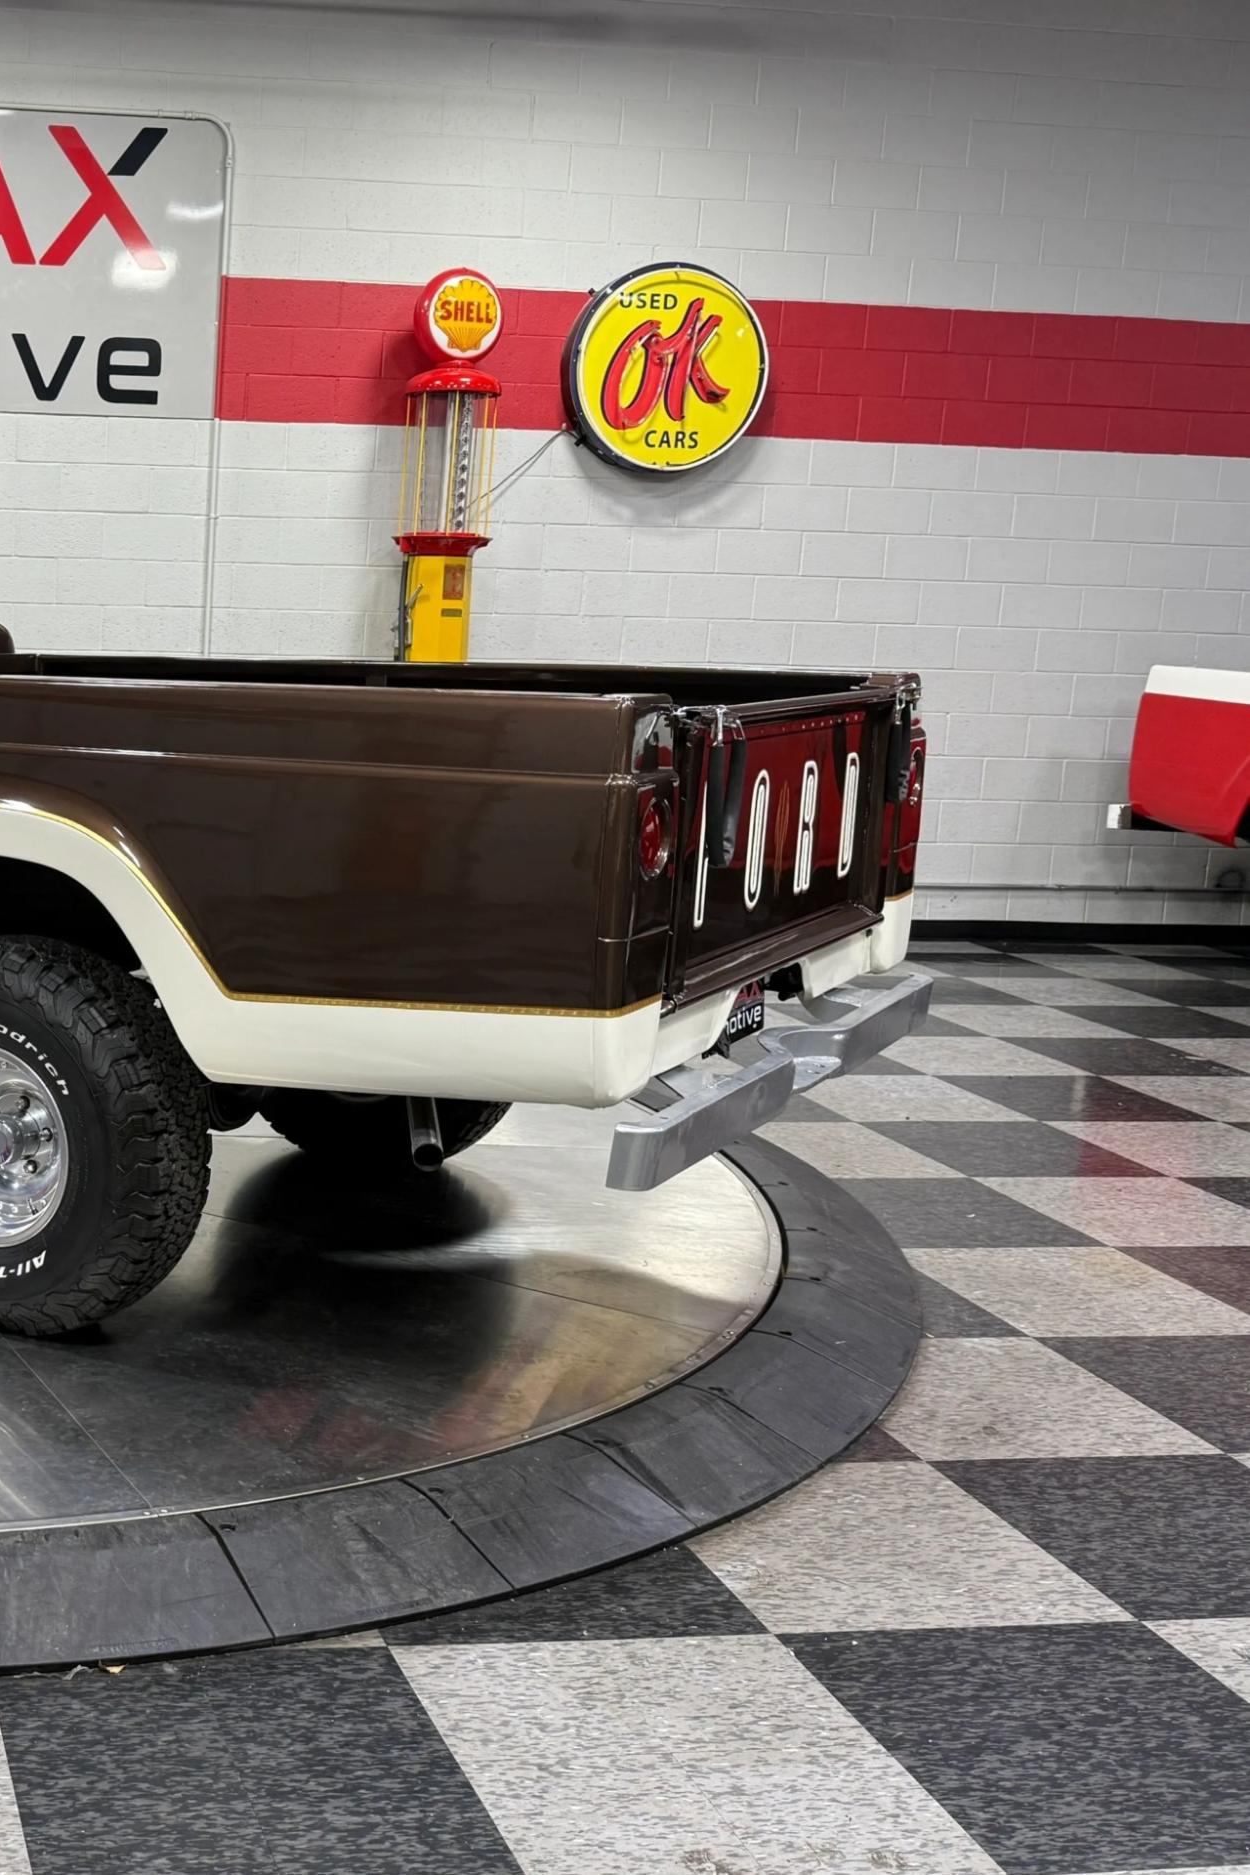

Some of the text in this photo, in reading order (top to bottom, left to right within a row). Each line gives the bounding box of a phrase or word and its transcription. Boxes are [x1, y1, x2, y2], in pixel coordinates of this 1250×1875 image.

[439, 299, 493, 325] SHELL
[619, 291, 678, 311] USED
[601, 297, 730, 431] OK
[643, 430, 699, 450] CARS
[726, 1005, 762, 1036] otive
